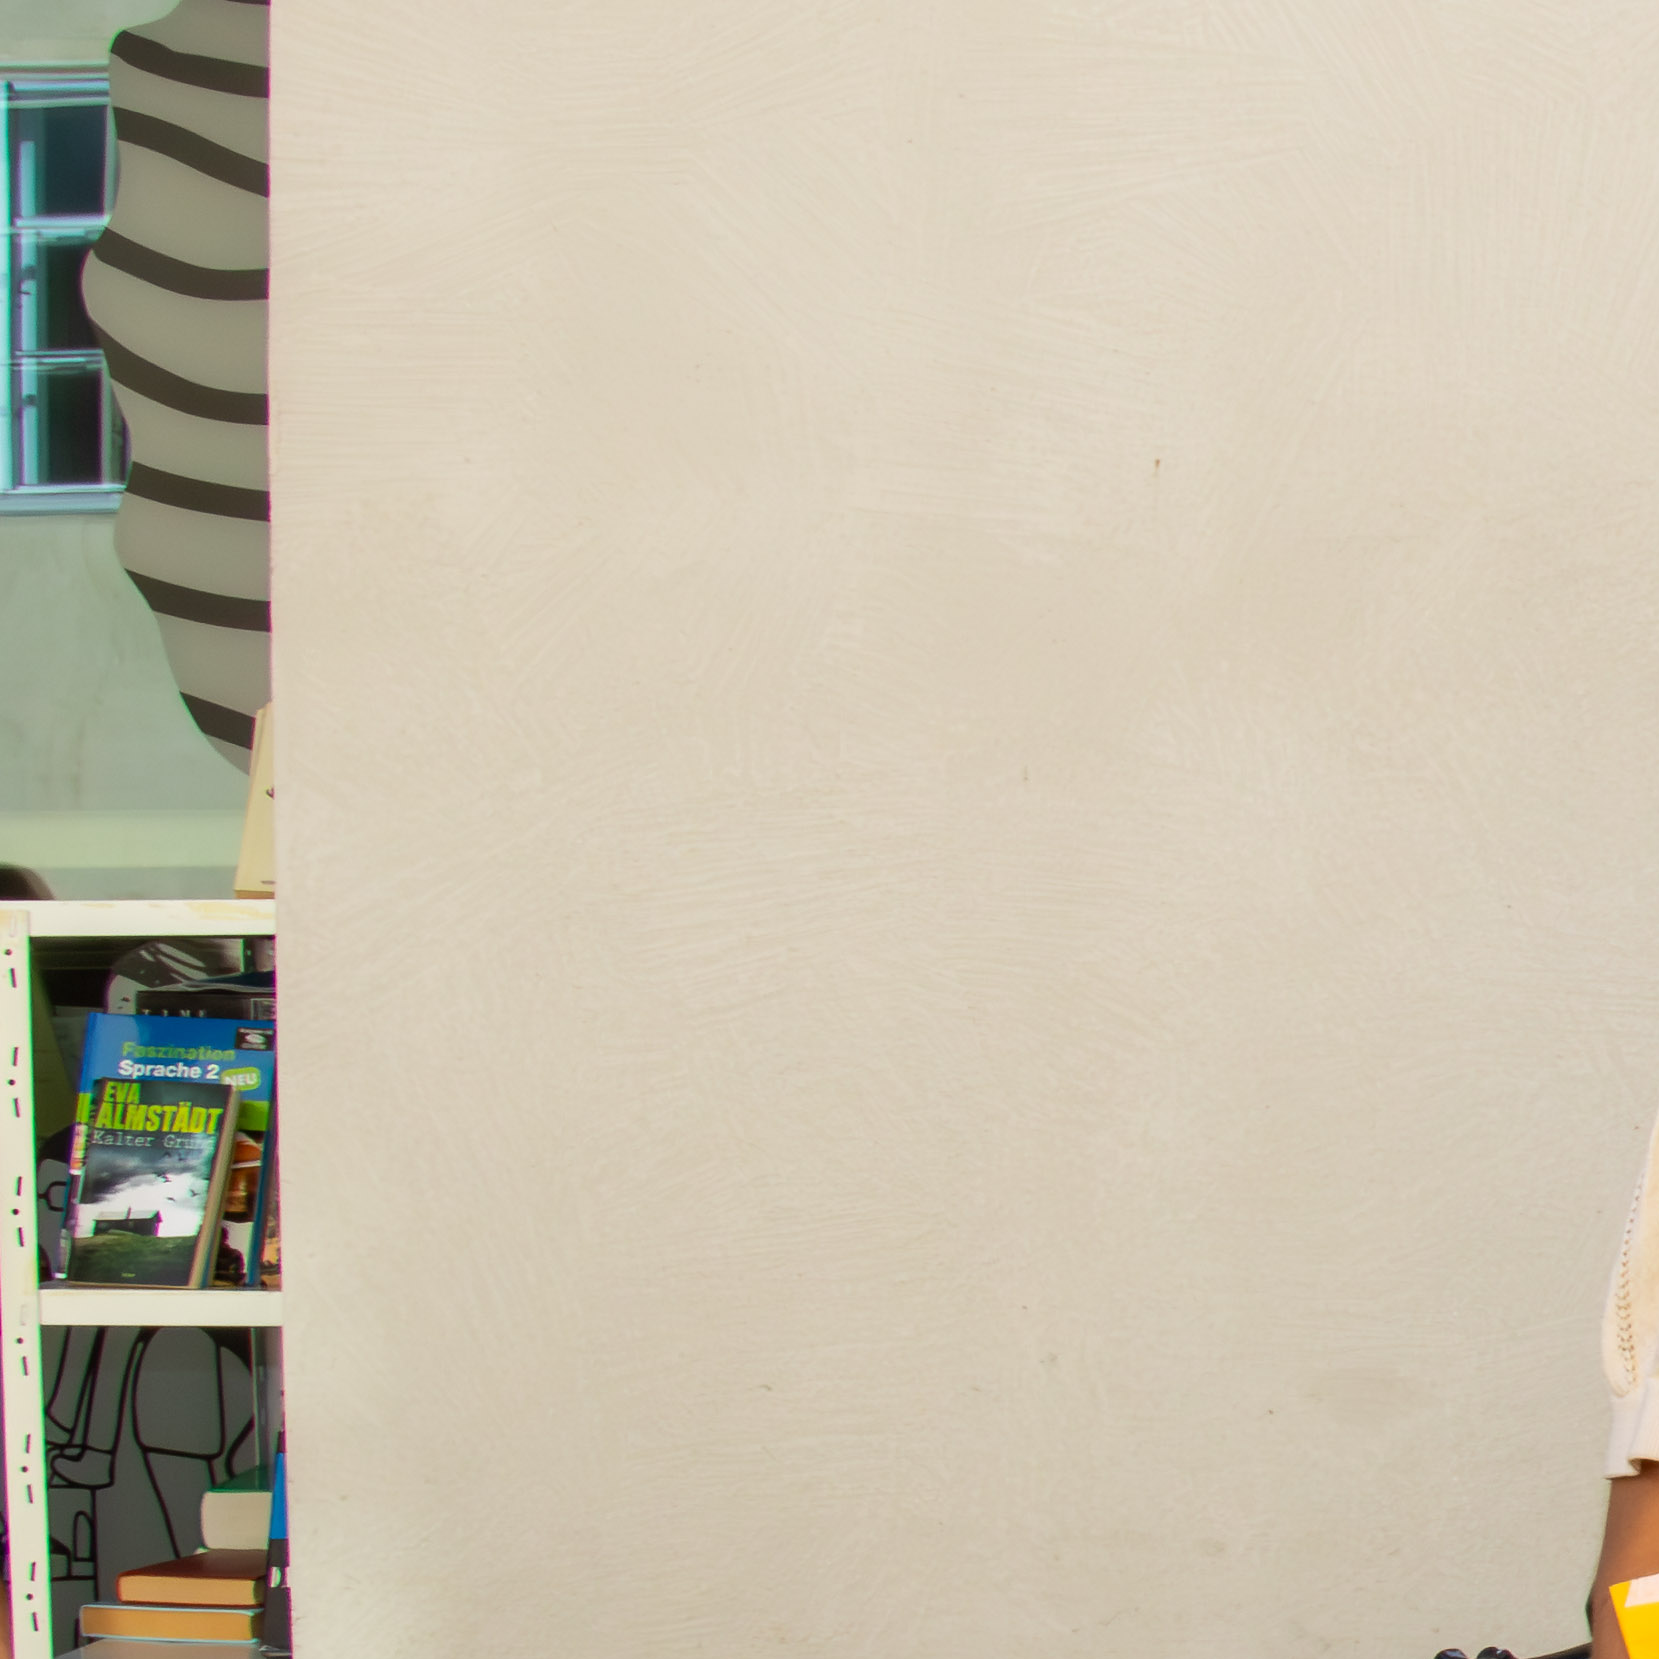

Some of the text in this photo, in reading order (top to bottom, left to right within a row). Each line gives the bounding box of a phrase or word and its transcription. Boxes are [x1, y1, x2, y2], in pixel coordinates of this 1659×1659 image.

[121, 1041, 236, 1062] Faszination
[118, 1059, 220, 1080] Sprache 2
[223, 1073, 257, 1087] NEU
[103, 1081, 141, 1104] EVA
[95, 1101, 224, 1135] ALMSTÄDT
[91, 1129, 156, 1148] Kalter
